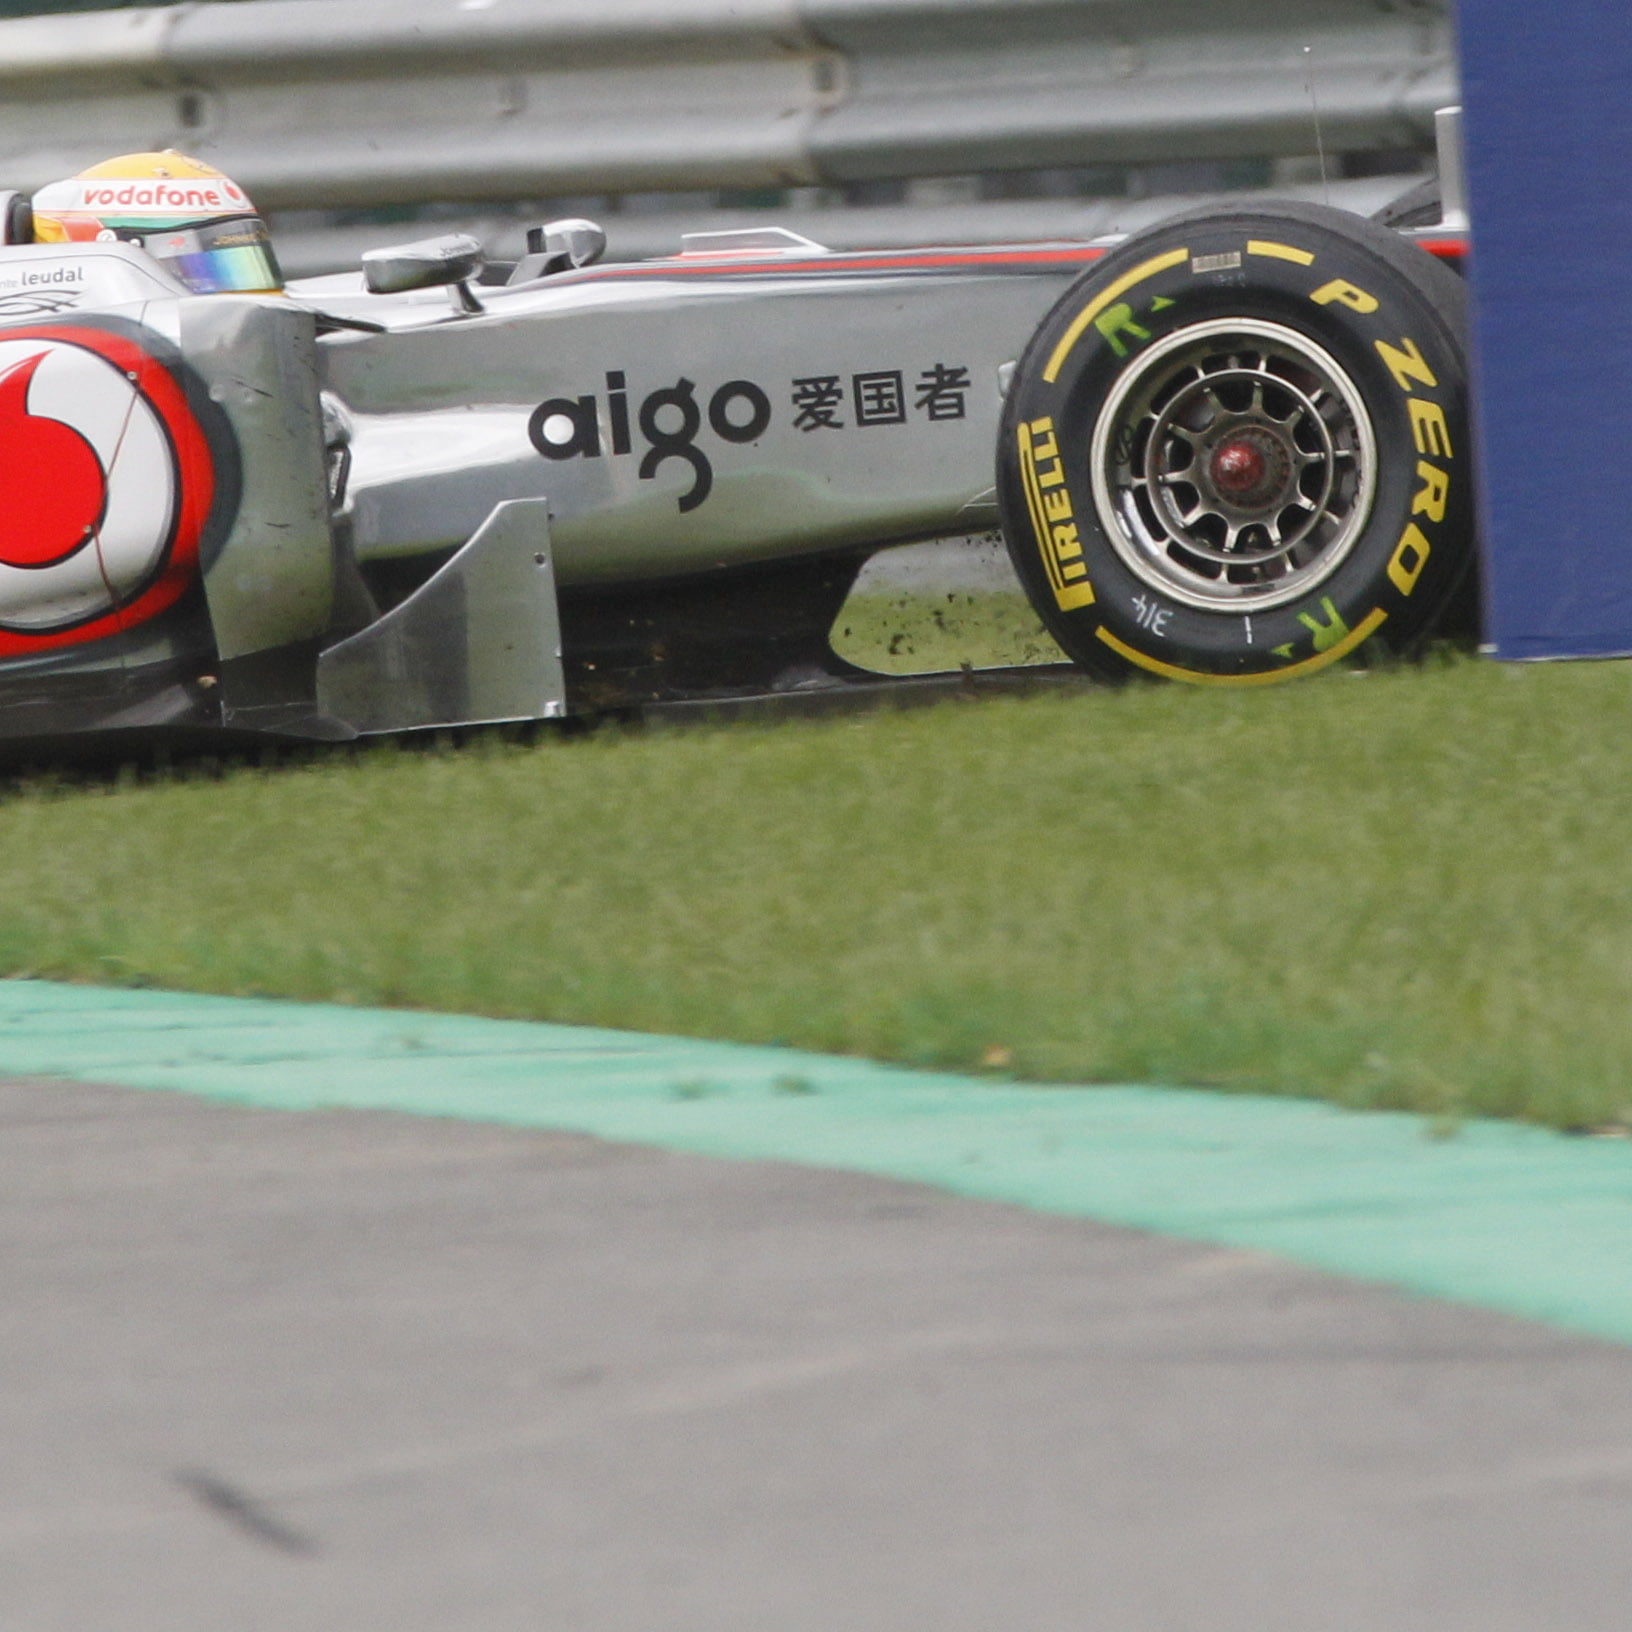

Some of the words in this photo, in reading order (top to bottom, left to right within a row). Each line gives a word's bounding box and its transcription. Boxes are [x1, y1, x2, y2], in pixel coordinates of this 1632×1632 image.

[84, 184, 221, 206] vodafone
[20, 266, 85, 287] leudal
[790, 364, 972, 433] 爱国者
[528, 369, 772, 514] aigo
[1309, 278, 1380, 315] P
[1374, 336, 1455, 598] ZERO
[1017, 415, 1097, 612] PIRELLI
[1131, 594, 1175, 637] 314
